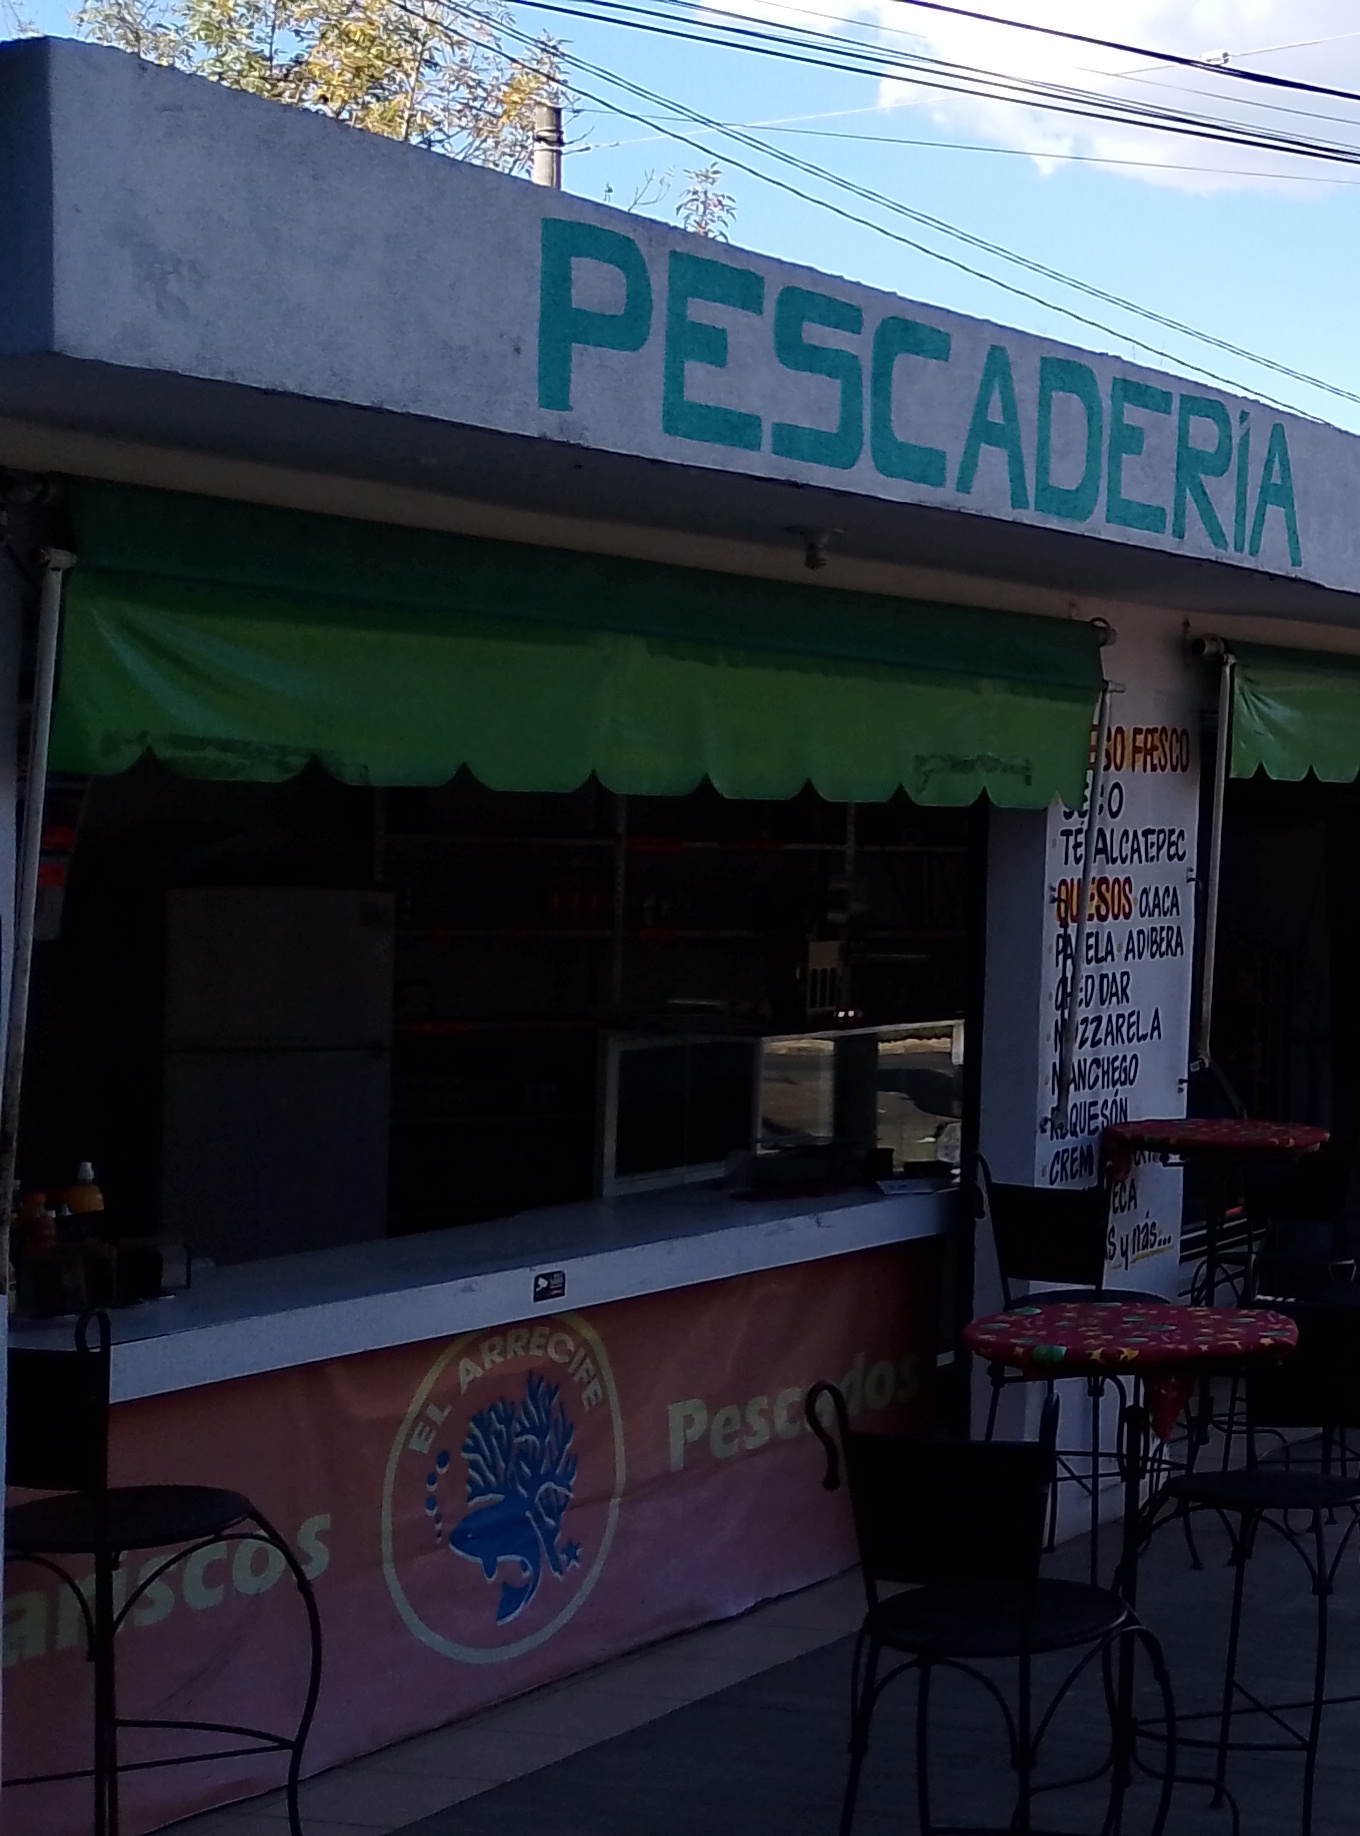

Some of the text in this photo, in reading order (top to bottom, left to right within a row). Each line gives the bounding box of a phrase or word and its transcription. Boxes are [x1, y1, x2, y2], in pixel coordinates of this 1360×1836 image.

[536, 217, 1303, 568] PESCADERÍA
[1055, 930, 1116, 968] PAELA
[409, 1325, 605, 1455] EL ARRECIFE
[2, 1512, 333, 1667] ariscos
